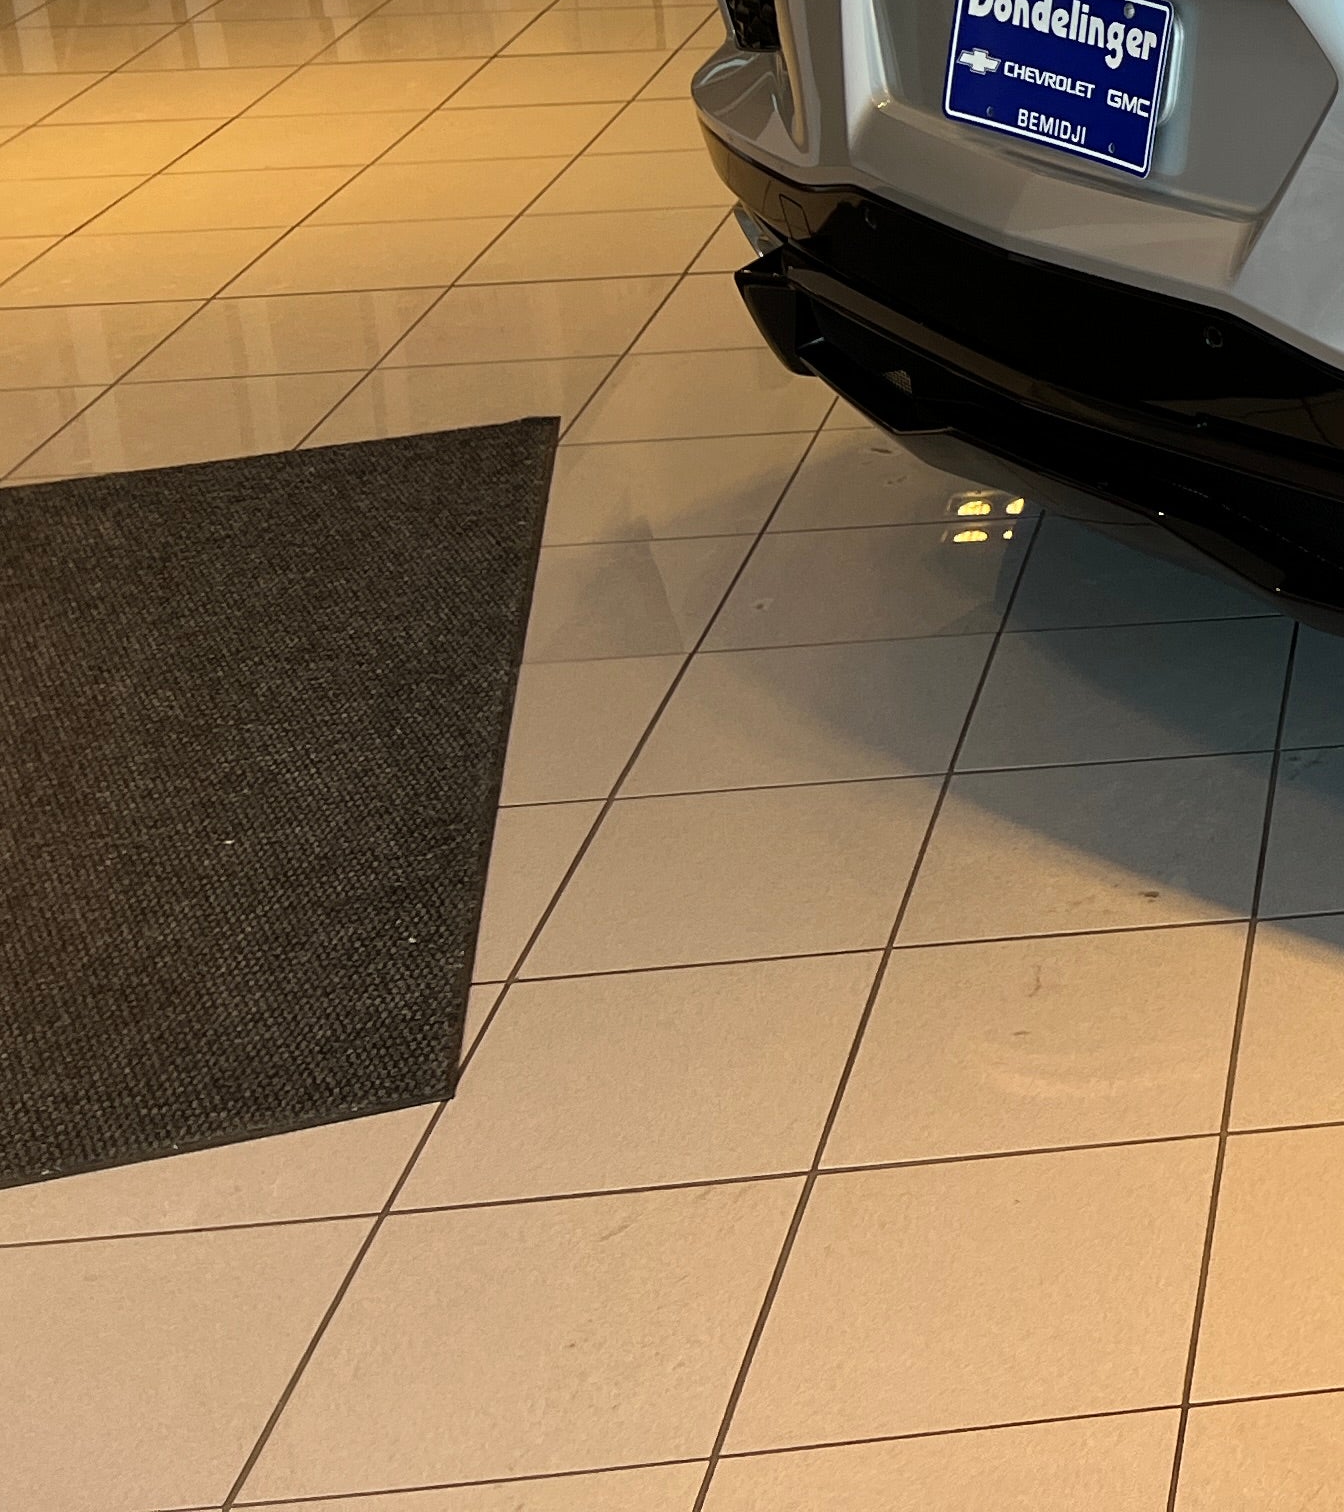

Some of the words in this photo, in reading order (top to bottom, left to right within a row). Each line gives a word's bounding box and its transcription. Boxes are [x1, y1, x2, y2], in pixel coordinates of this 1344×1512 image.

[1004, 61, 1095, 99] CHEVROLET
[1107, 89, 1151, 117] GMC
[1017, 108, 1087, 145] BEMIDJI
